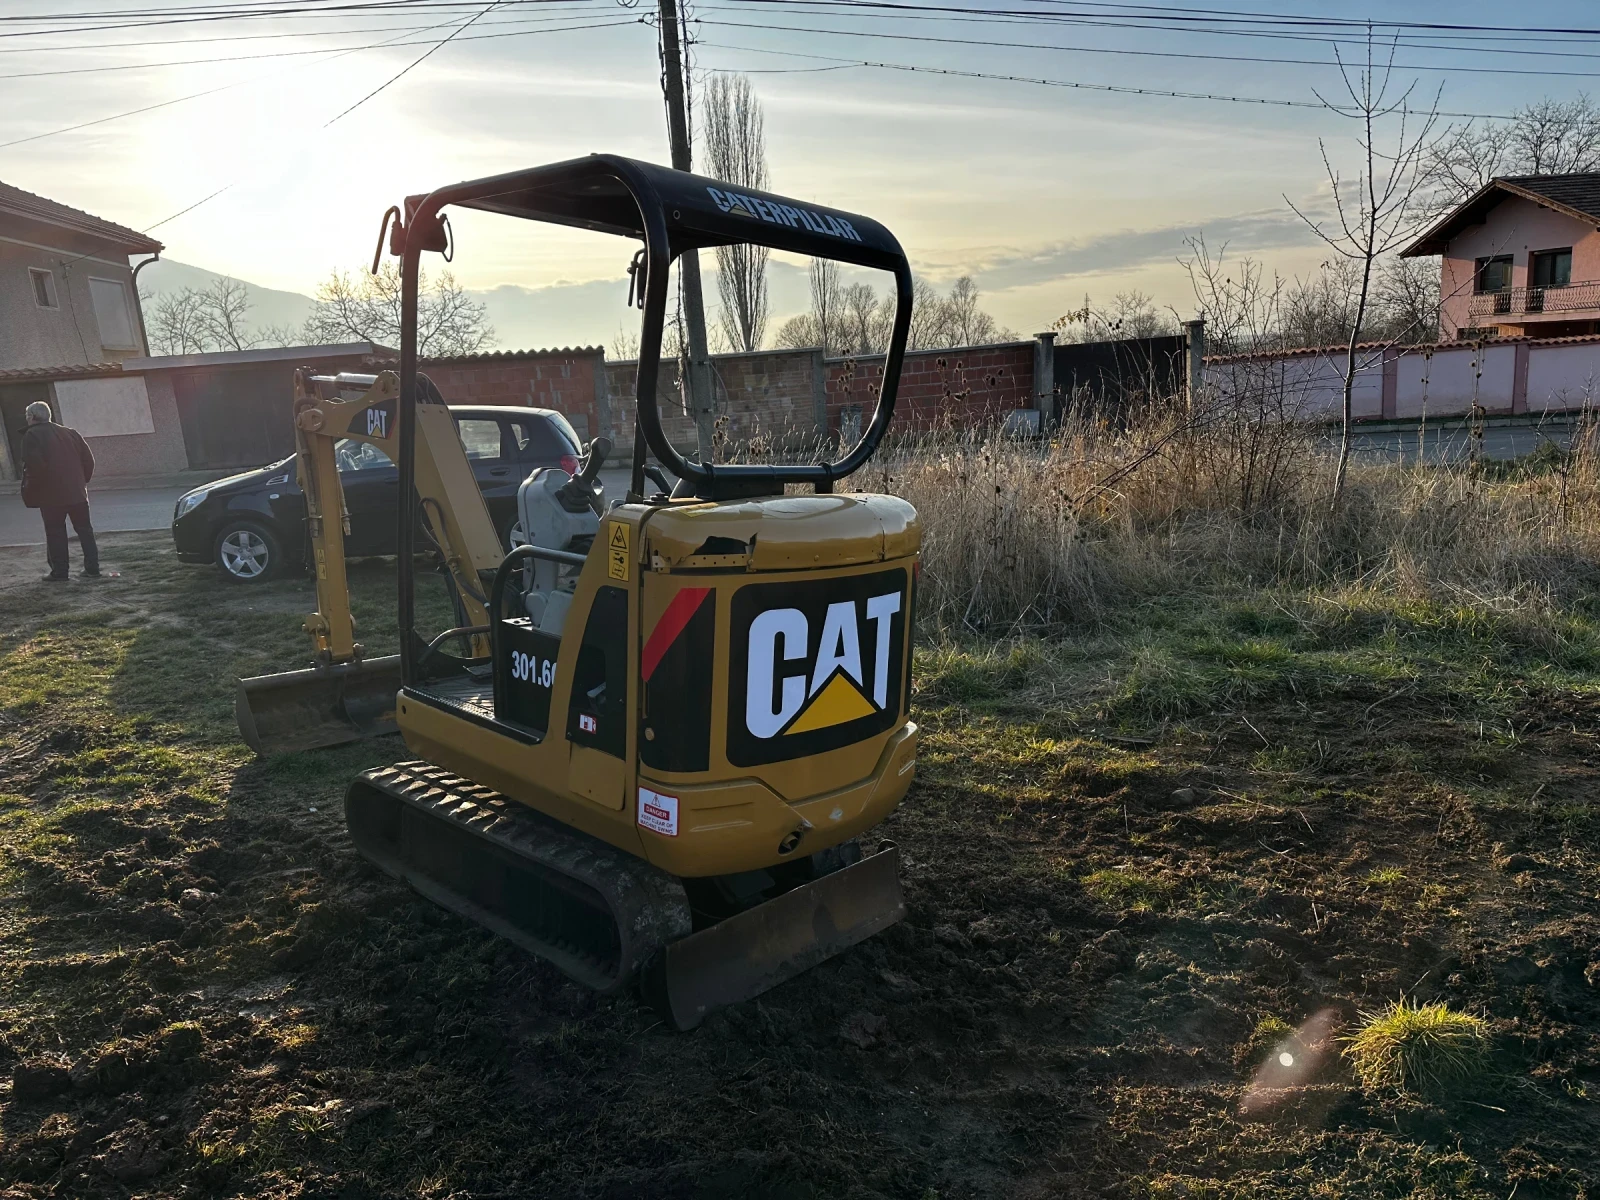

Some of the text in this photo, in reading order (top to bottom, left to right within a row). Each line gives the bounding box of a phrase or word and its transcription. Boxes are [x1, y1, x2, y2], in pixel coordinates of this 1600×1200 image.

[706, 187, 862, 241] CATERPILLAR
[367, 409, 387, 438] CAT
[745, 591, 901, 738] CAT
[645, 805, 668, 819] DANGER
[652, 818, 665, 827] CLEAR
